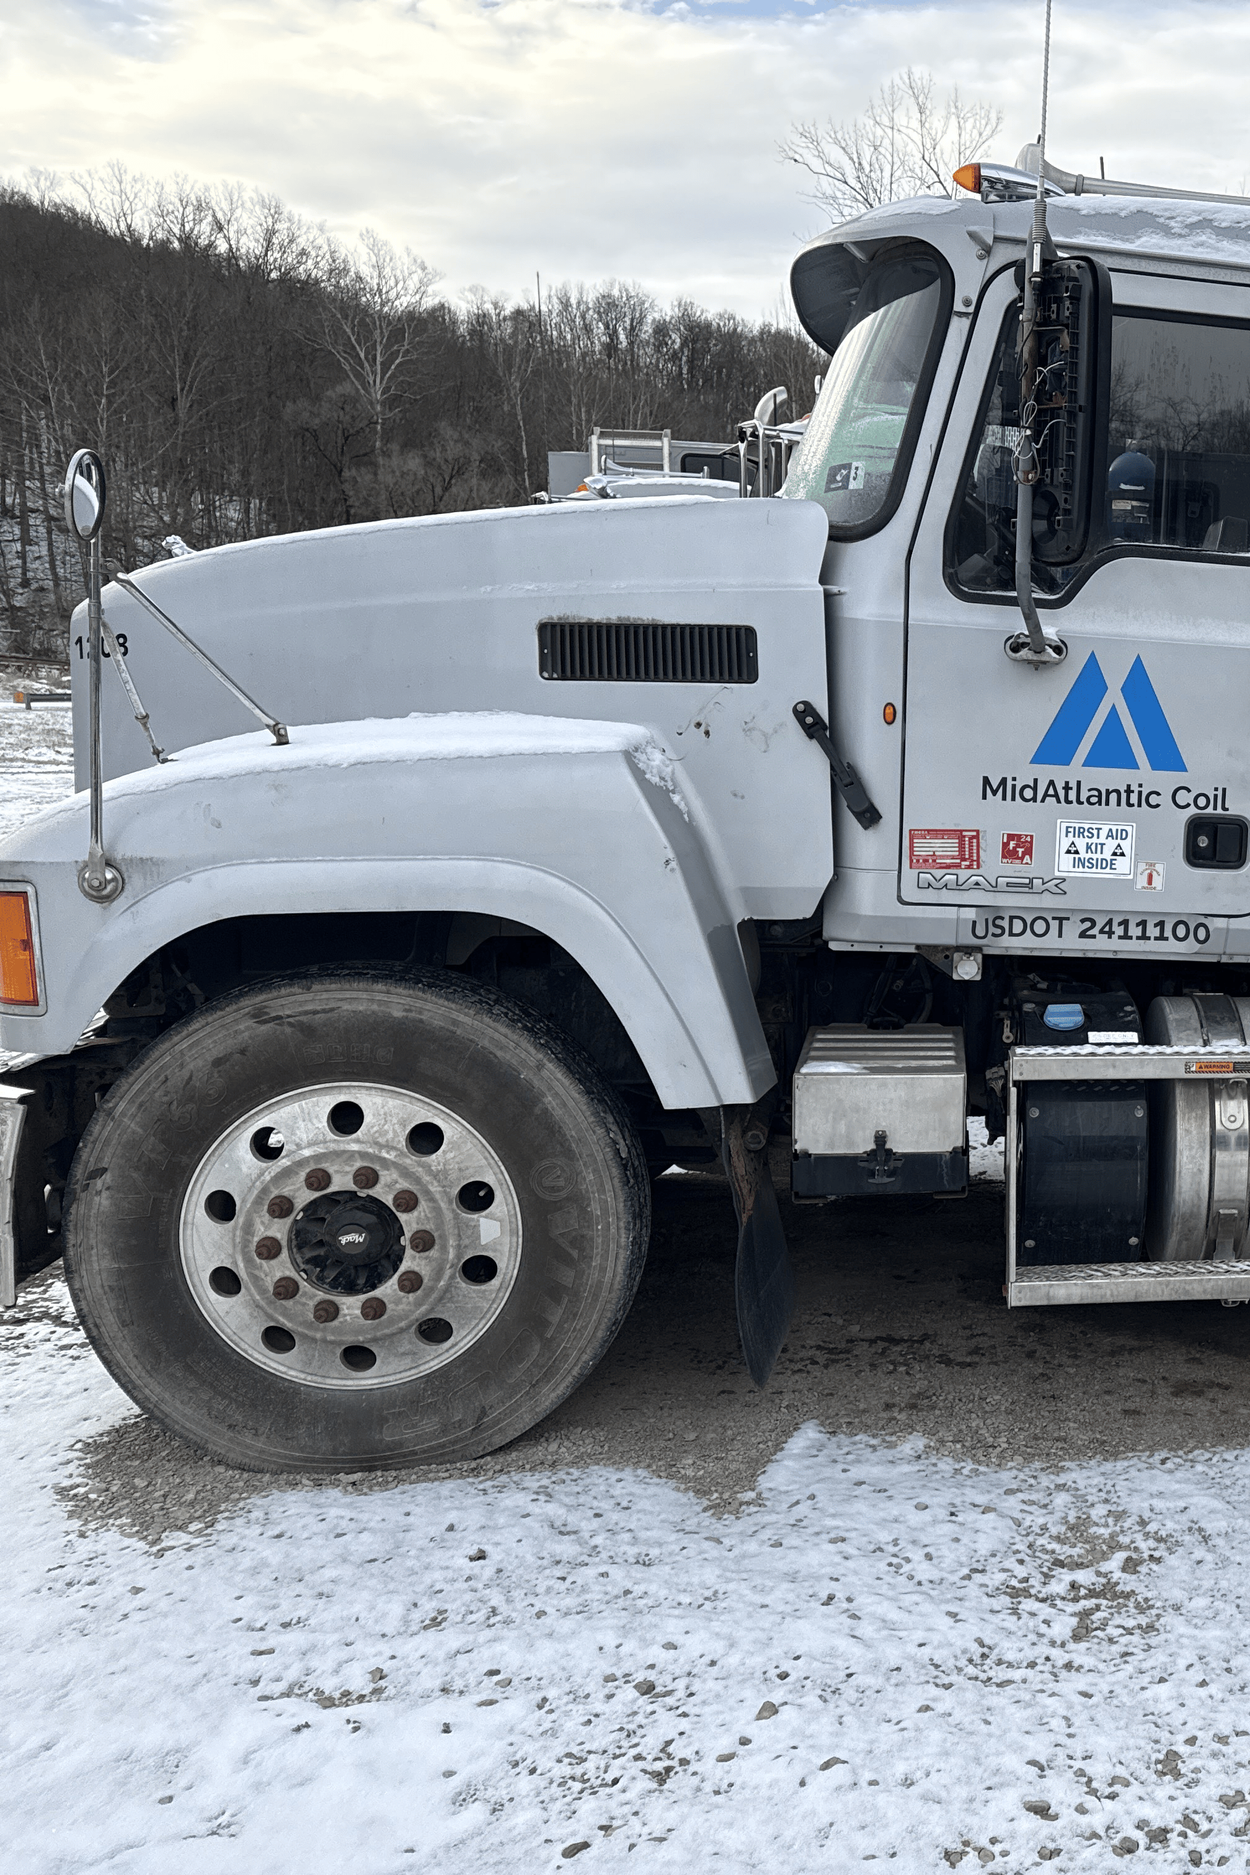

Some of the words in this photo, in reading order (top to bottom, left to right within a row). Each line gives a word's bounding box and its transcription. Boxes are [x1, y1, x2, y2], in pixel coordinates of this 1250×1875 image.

[981, 775, 1162, 809] MidAtlantic
[1171, 785, 1229, 811] Coil
[1065, 826, 1102, 840] FIRST
[1105, 828, 1129, 840] AID
[1085, 842, 1106, 855] KIT
[1072, 857, 1117, 870] INSIDE
[917, 871, 1067, 895] MACK
[971, 915, 1070, 940] USDOT
[1078, 917, 1211, 944] 2411100
[338, 1233, 366, 1246] Mack
